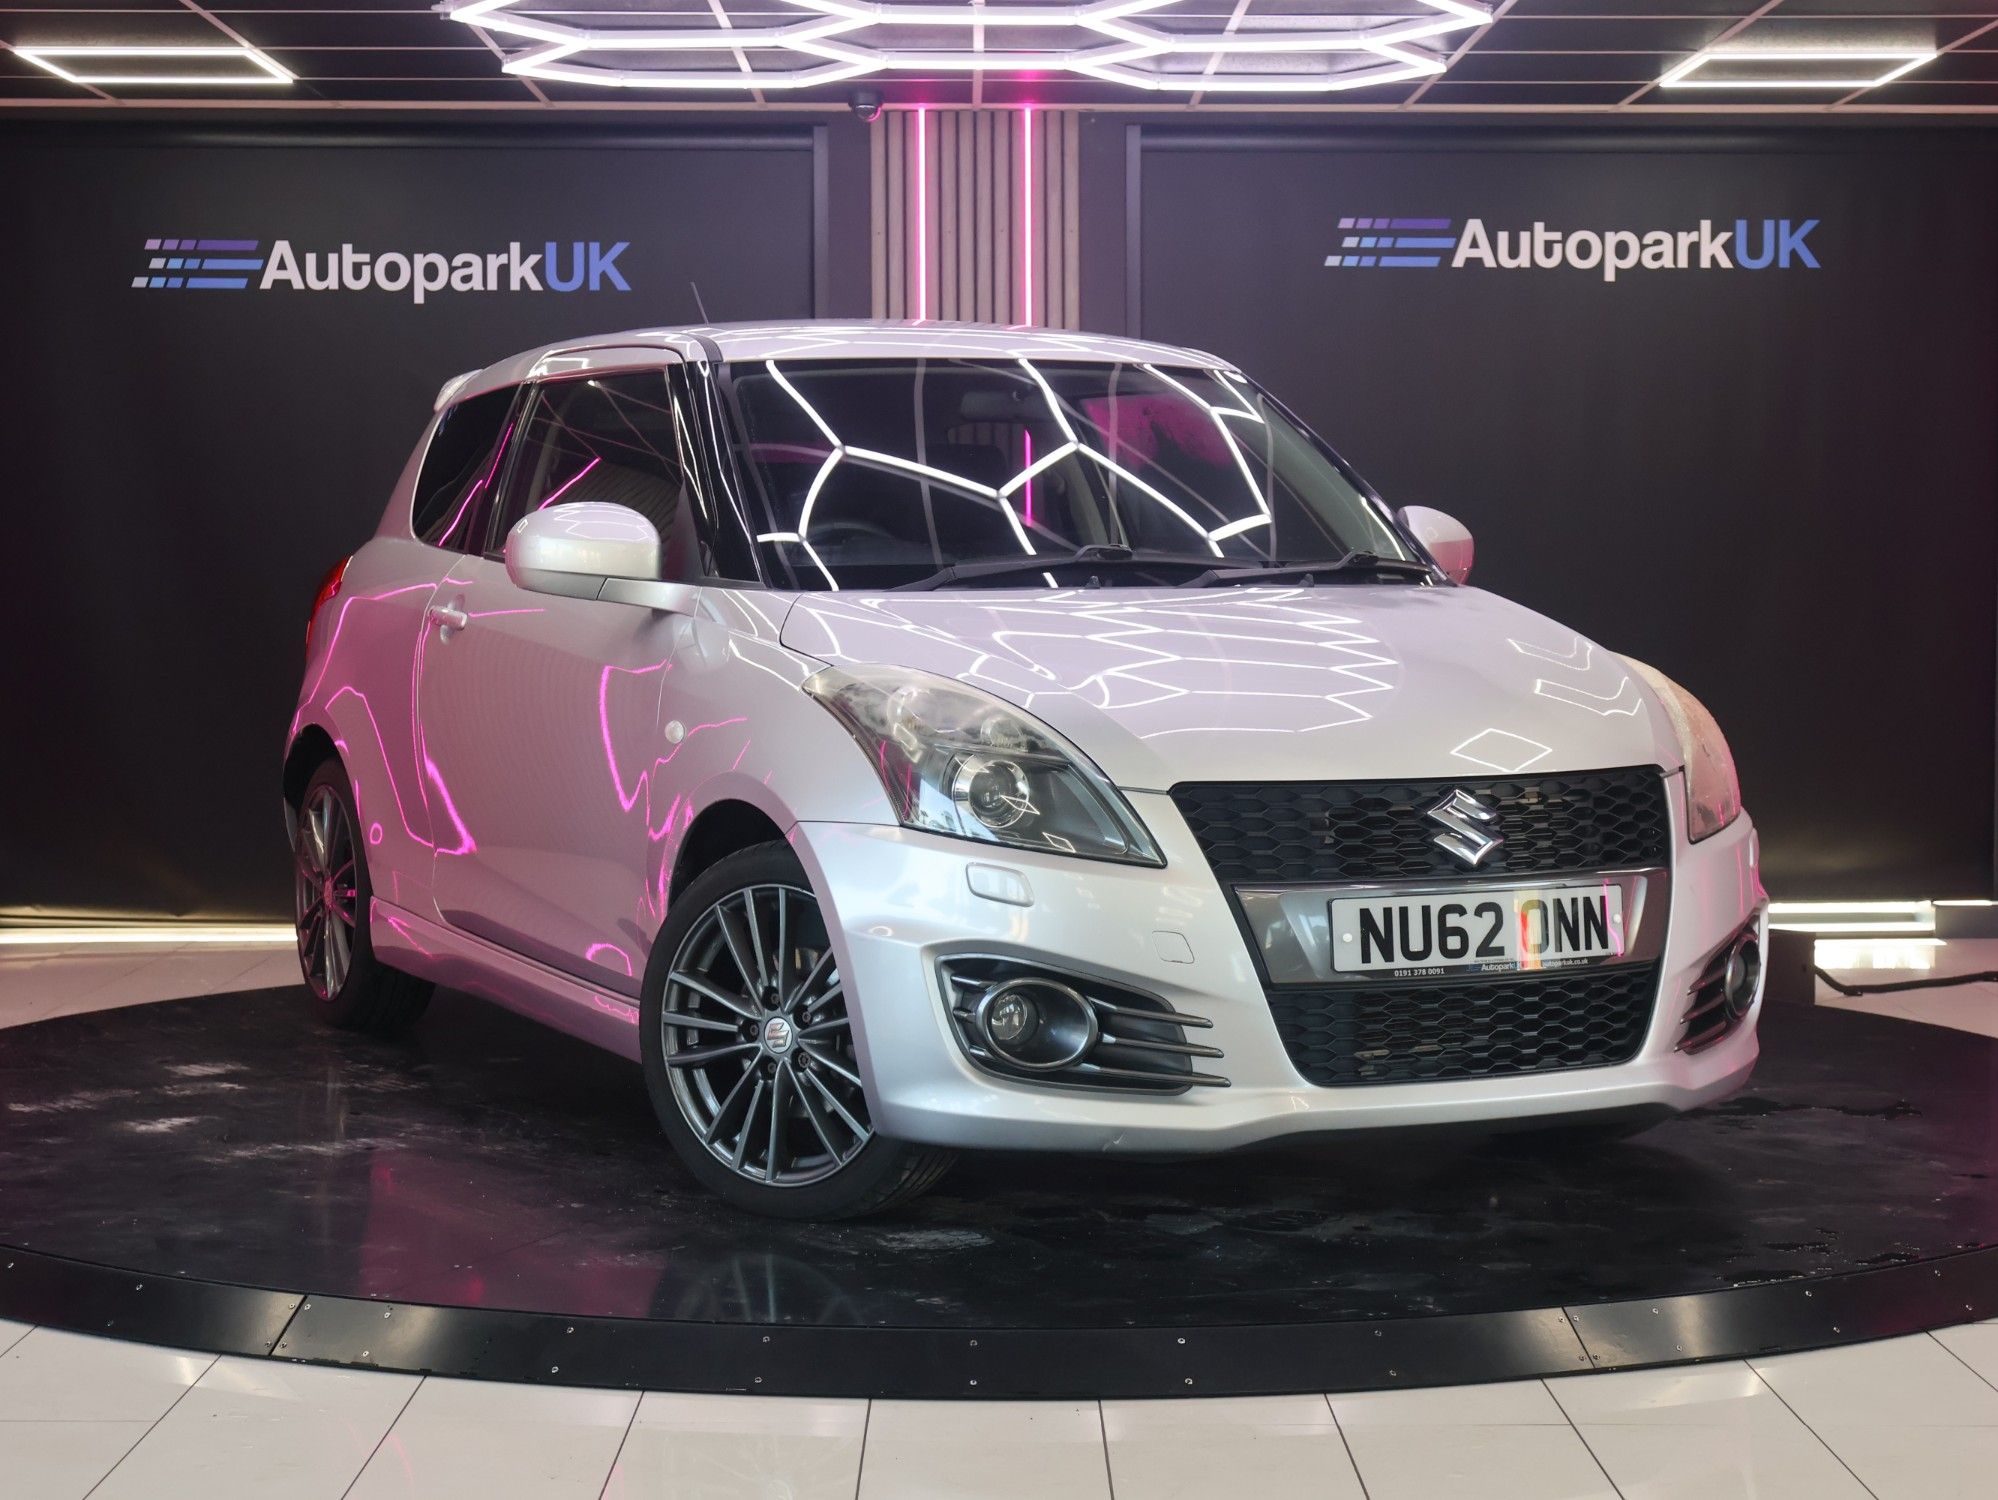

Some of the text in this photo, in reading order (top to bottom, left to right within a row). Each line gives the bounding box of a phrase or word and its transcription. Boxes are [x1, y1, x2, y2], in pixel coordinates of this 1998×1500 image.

[259, 239, 632, 305] AutoparkUK
[1451, 218, 1822, 282] AutoparkUK
[1359, 901, 1506, 965] NU62
[1393, 967, 1445, 977] 0191 378 0091
